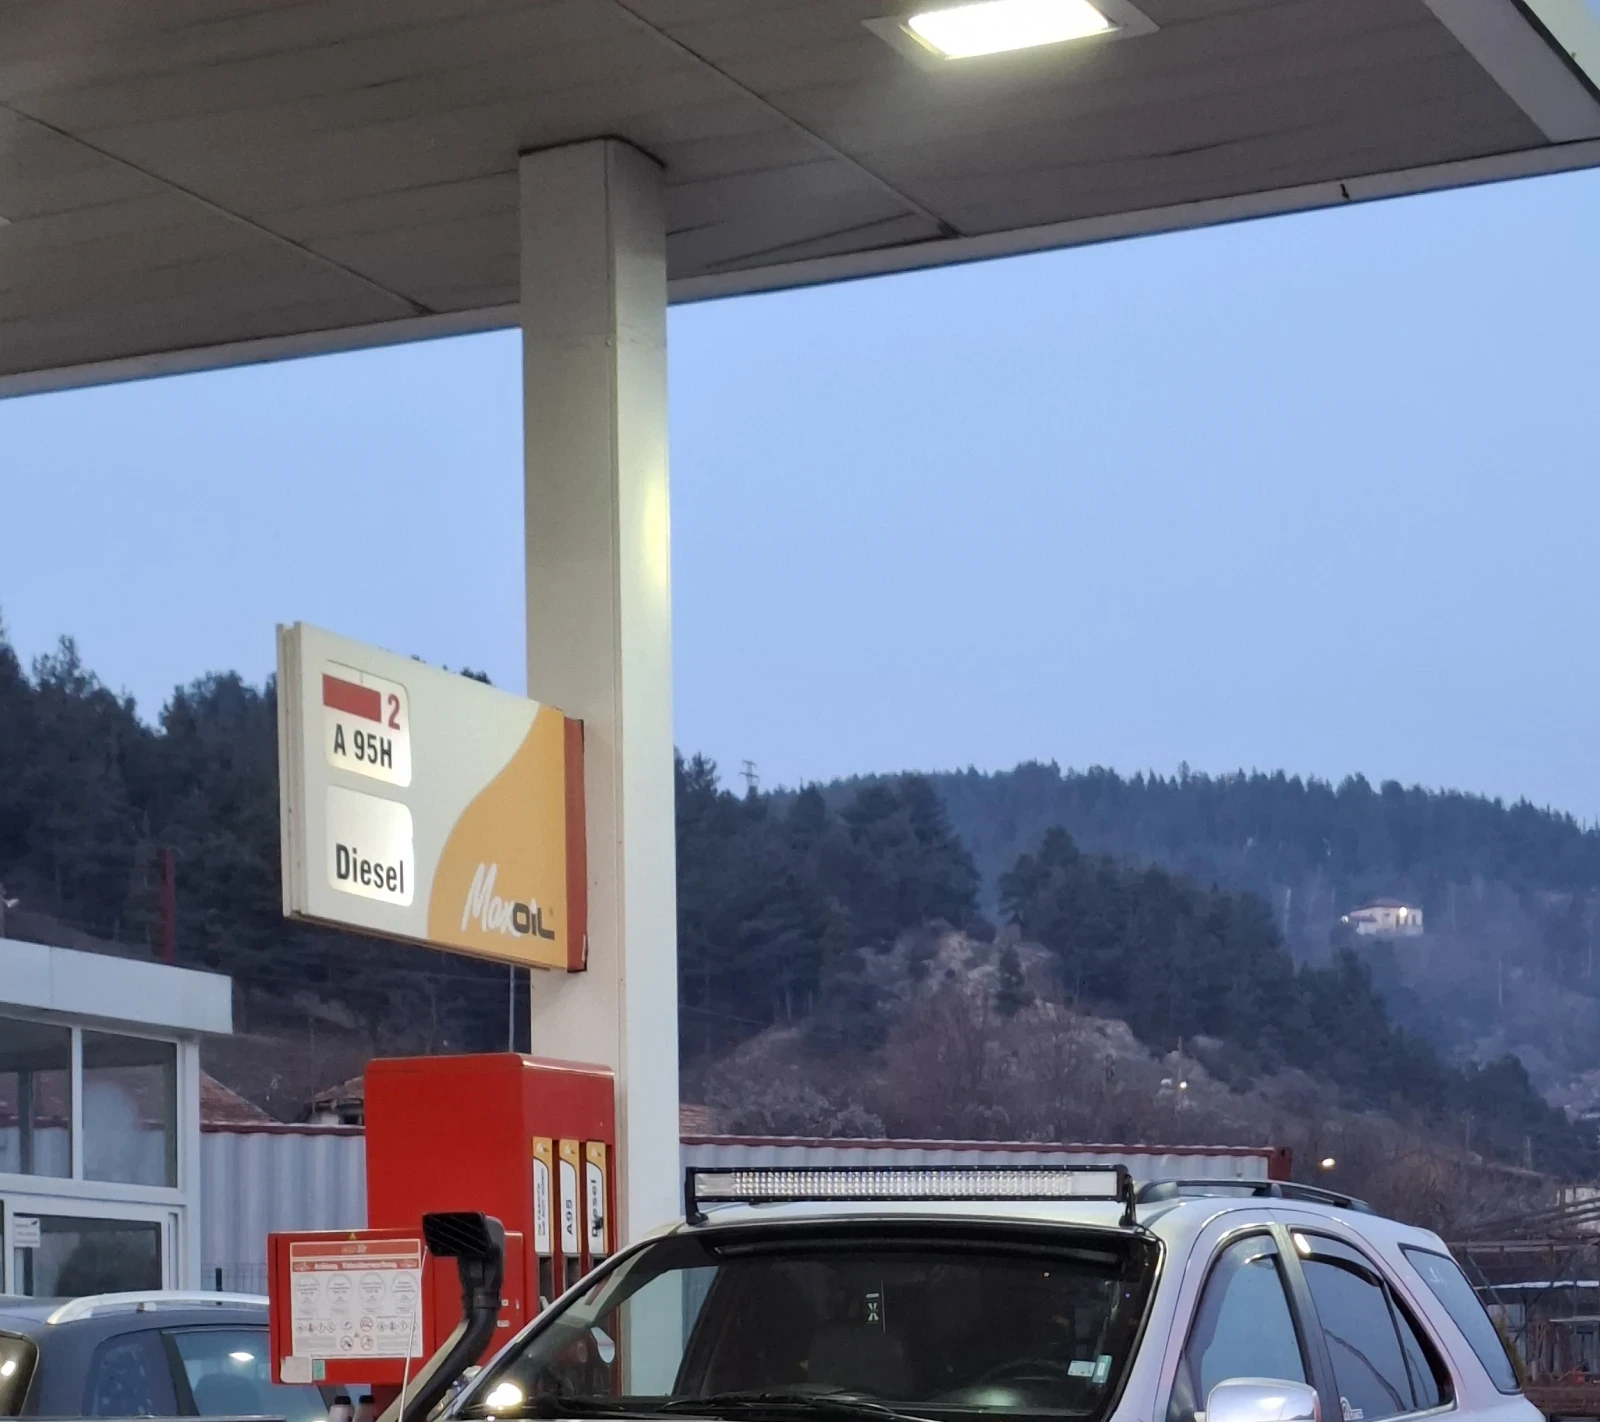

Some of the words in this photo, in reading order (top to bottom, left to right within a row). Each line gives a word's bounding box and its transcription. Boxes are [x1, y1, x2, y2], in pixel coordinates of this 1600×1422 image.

[387, 693, 401, 731] 2
[333, 723, 347, 757] A
[353, 728, 393, 770] 95H
[335, 842, 404, 894] Diesel
[565, 1199, 573, 1236] A95
